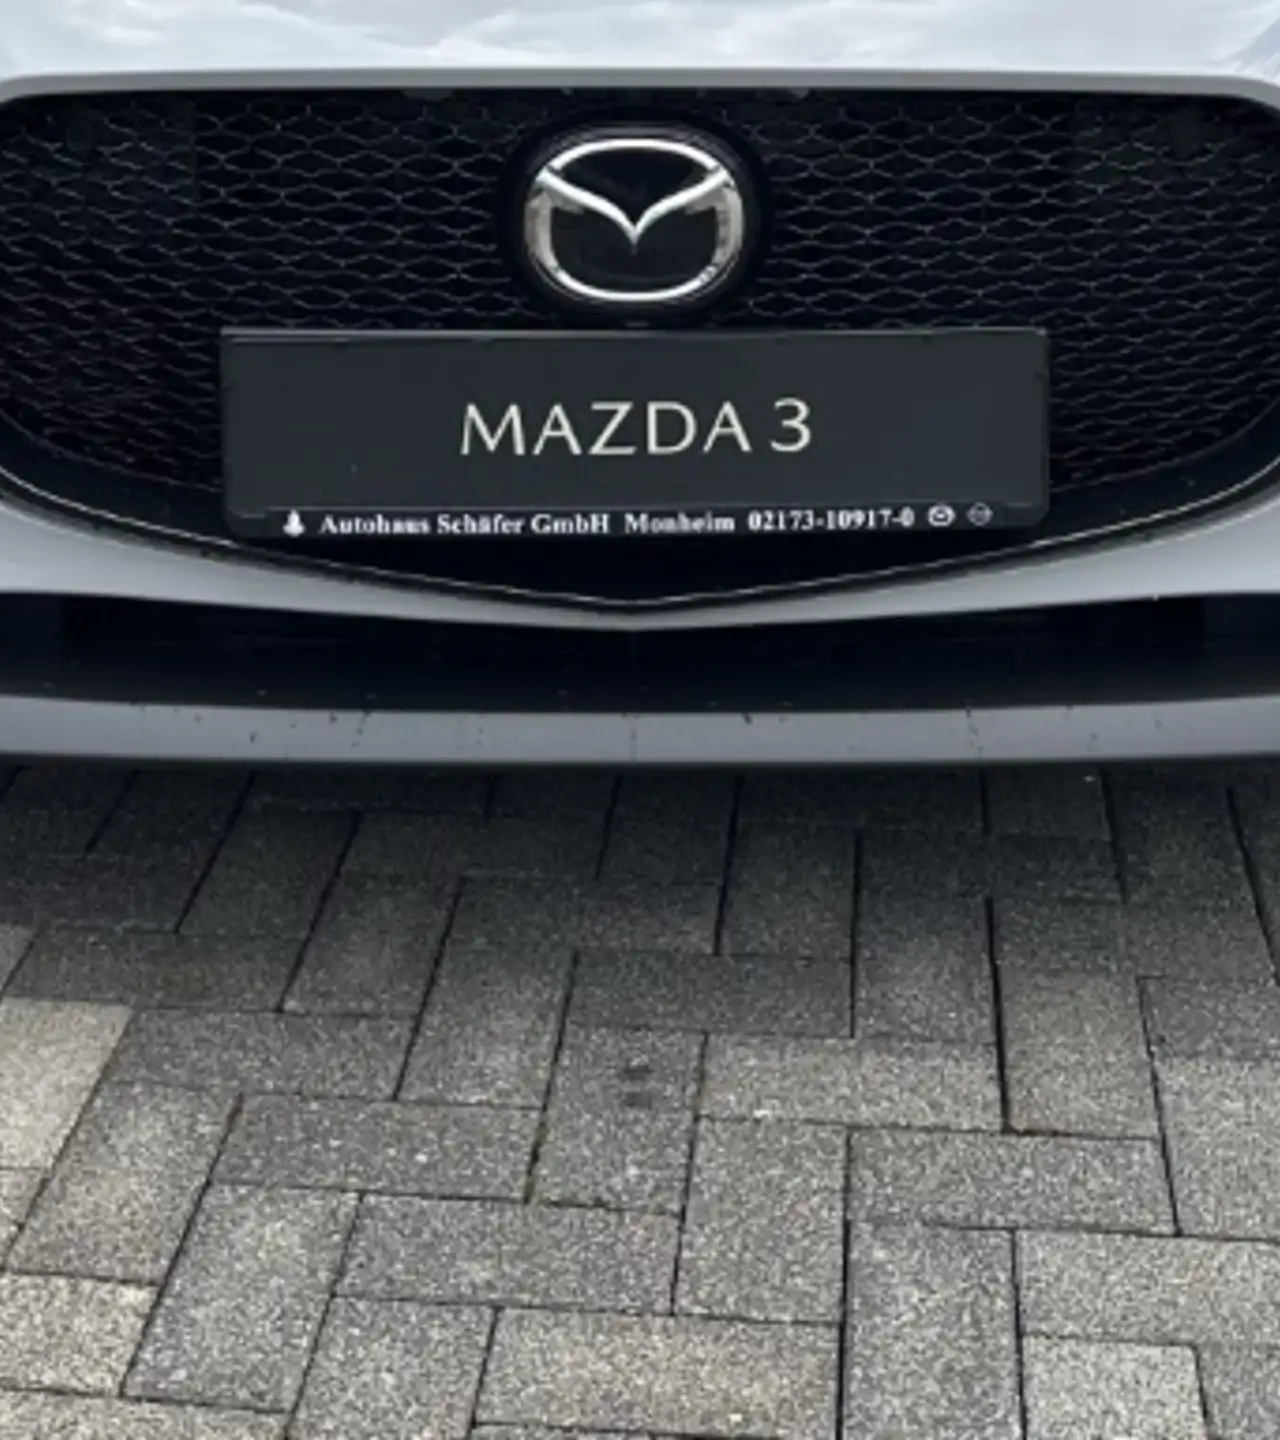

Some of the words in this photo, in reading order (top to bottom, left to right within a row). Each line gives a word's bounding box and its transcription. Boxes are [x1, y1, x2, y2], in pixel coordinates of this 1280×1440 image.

[460, 400, 753, 456] MAZDA
[769, 397, 813, 453] 3
[320, 512, 430, 535] Autohaus
[436, 512, 522, 535] Schäfer
[530, 512, 611, 535] GmbH
[624, 512, 736, 534] Monheim
[747, 507, 916, 532] 02173-10917-0
